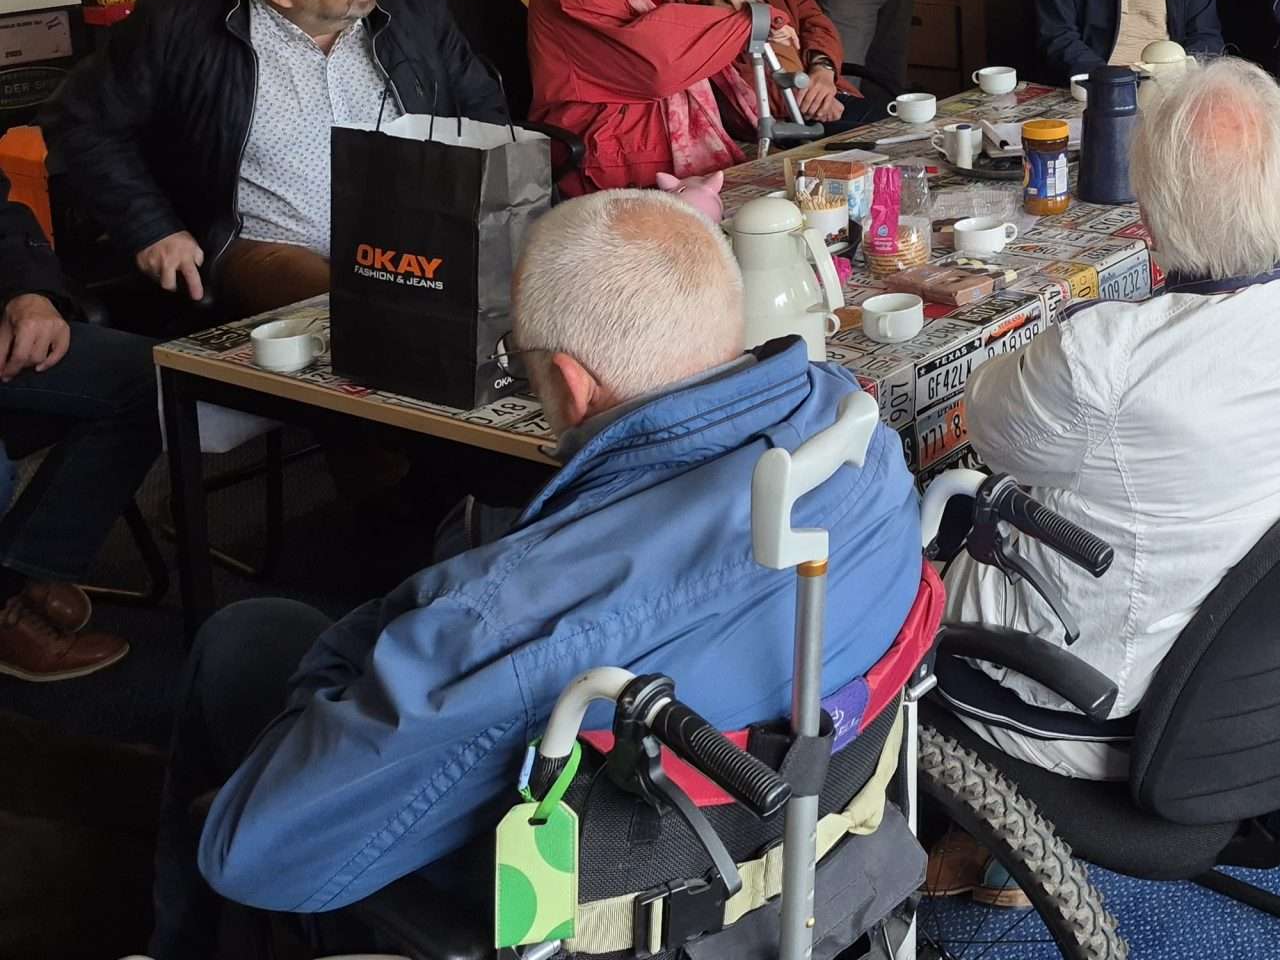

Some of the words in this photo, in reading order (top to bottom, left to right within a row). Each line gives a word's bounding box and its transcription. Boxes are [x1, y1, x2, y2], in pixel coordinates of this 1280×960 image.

[356, 243, 443, 279] OKAY
[354, 265, 395, 282] FASHION
[396, 275, 405, 285] &
[406, 277, 444, 290] JEANS
[935, 346, 967, 367] TEXAS
[494, 375, 515, 389] OKA
